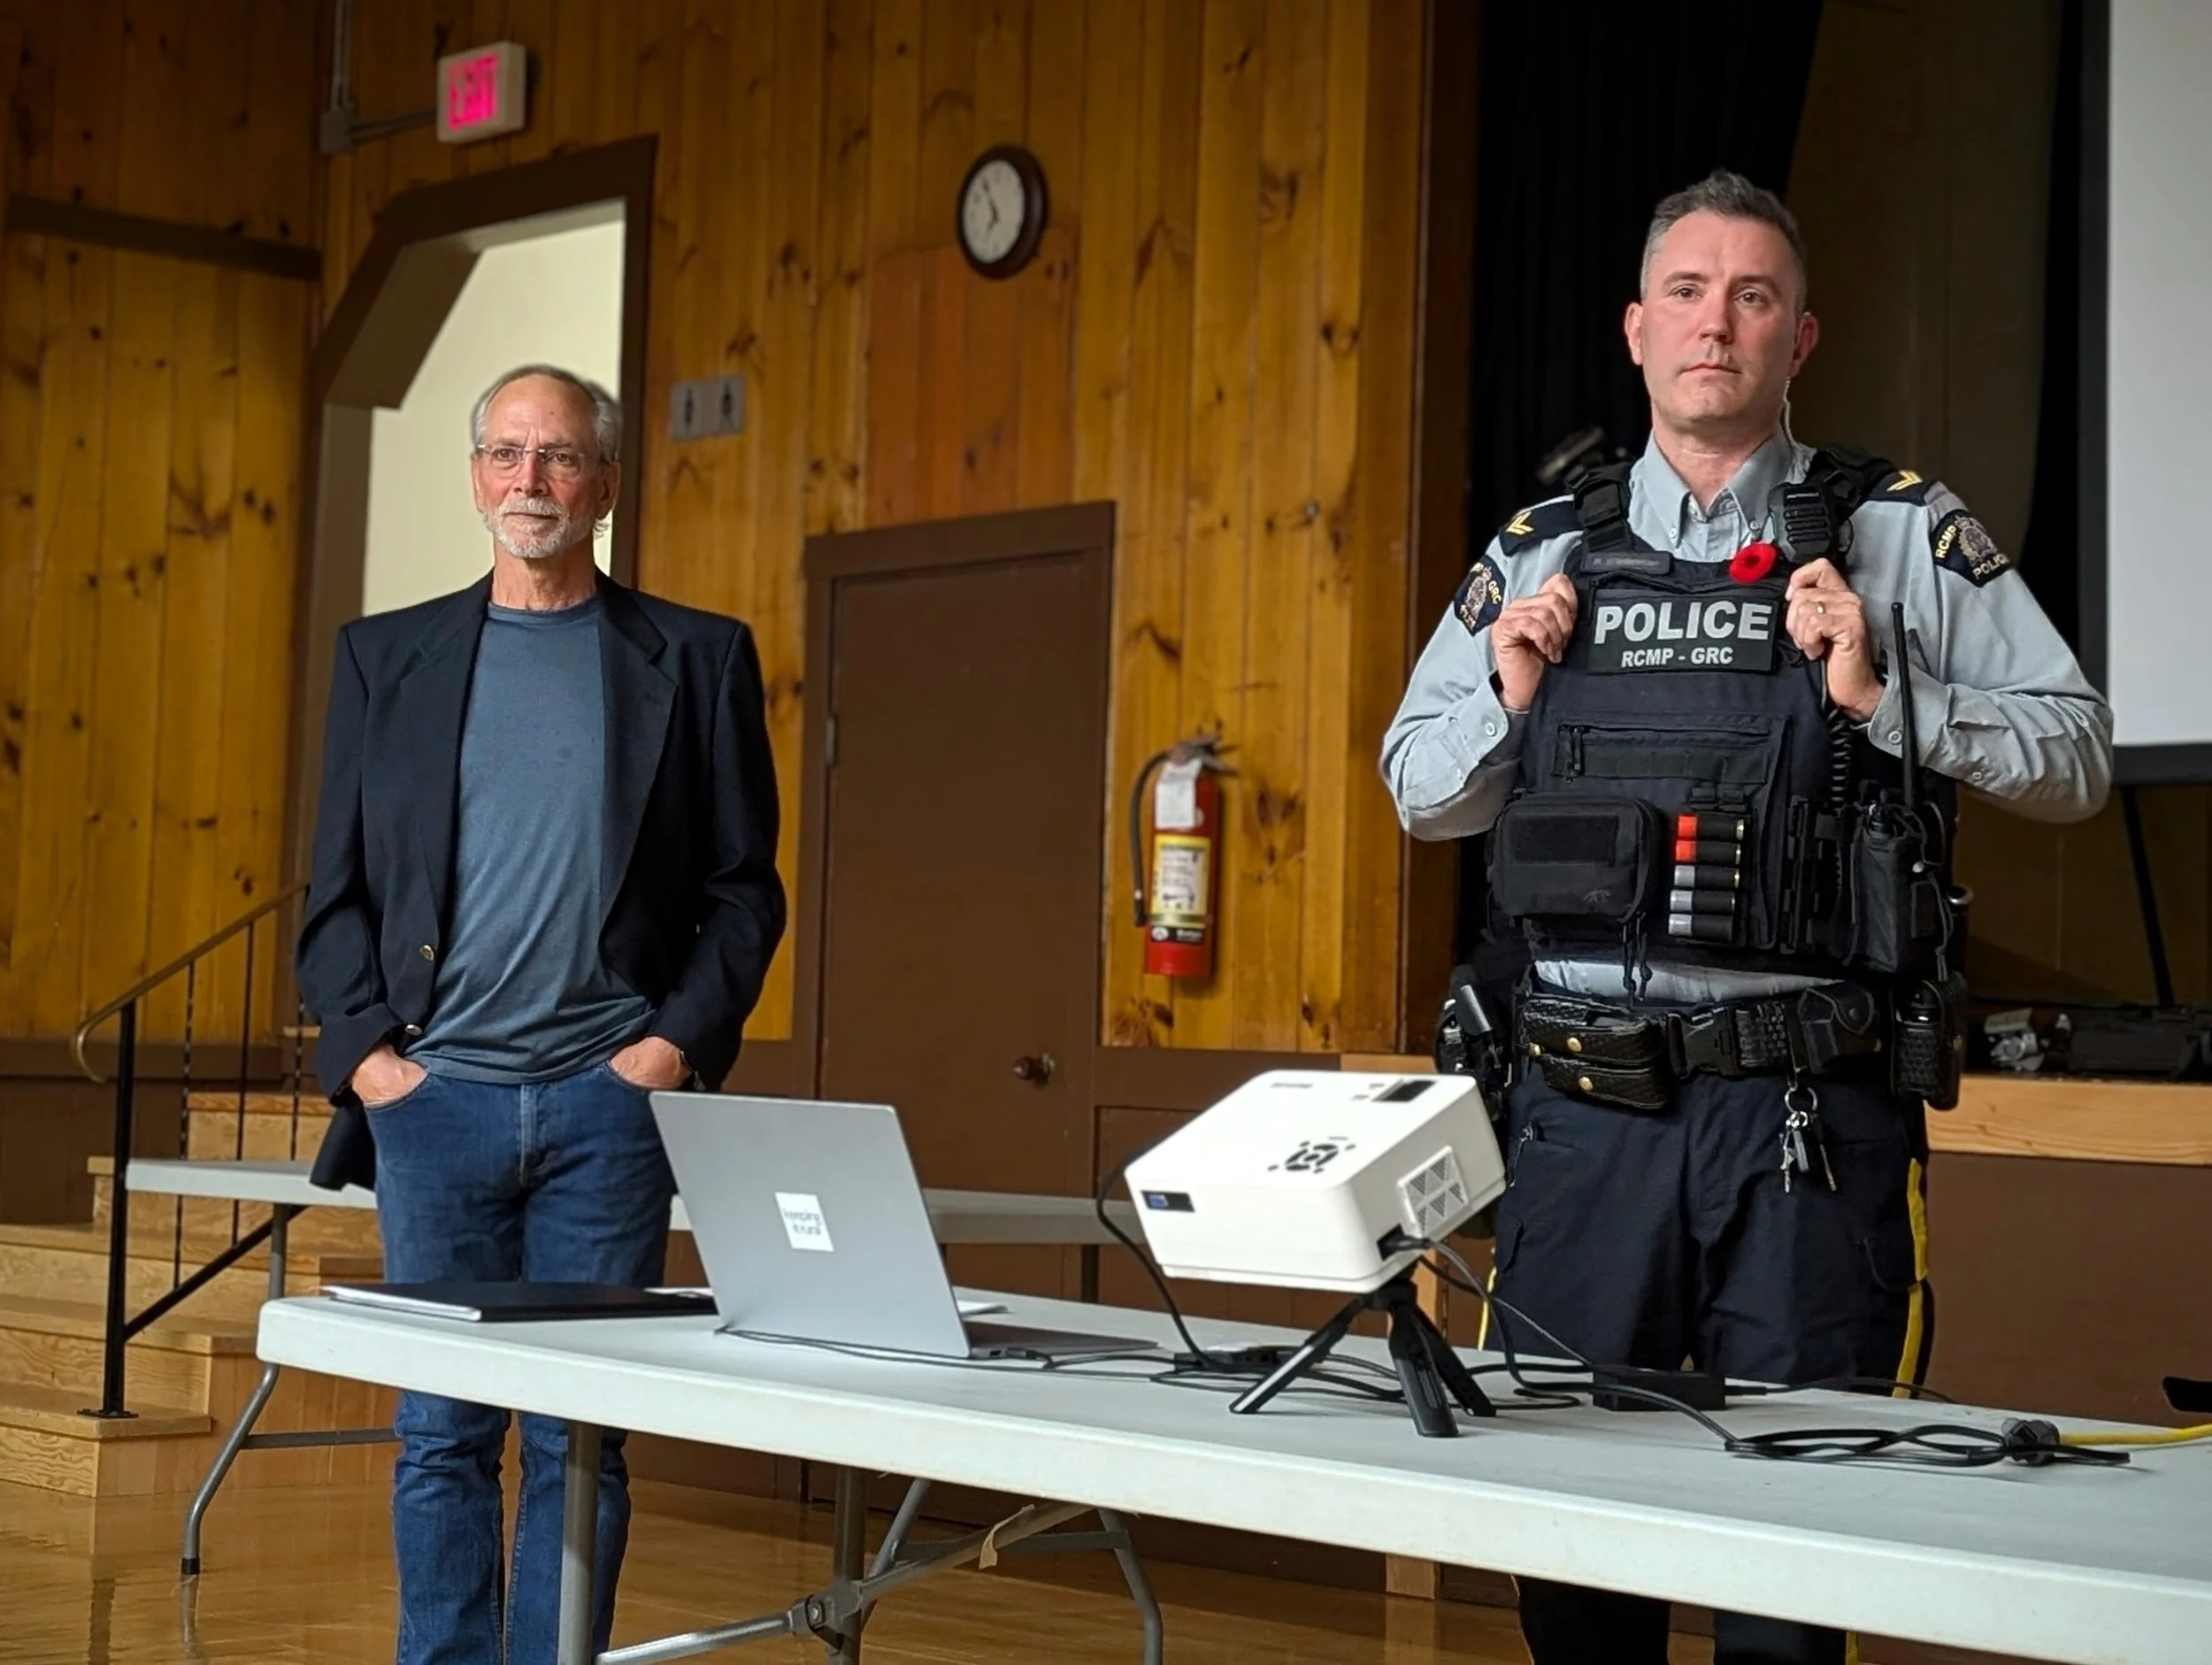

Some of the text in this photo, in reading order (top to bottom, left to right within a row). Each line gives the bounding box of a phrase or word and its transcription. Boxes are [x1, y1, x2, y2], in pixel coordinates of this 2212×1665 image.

[1935, 525, 1957, 559] RCMP
[1972, 554, 2009, 580] POLIC
[1594, 601, 1772, 645] POLICE
[1621, 648, 1674, 668] RCMP
[1691, 647, 1733, 664] GRC
